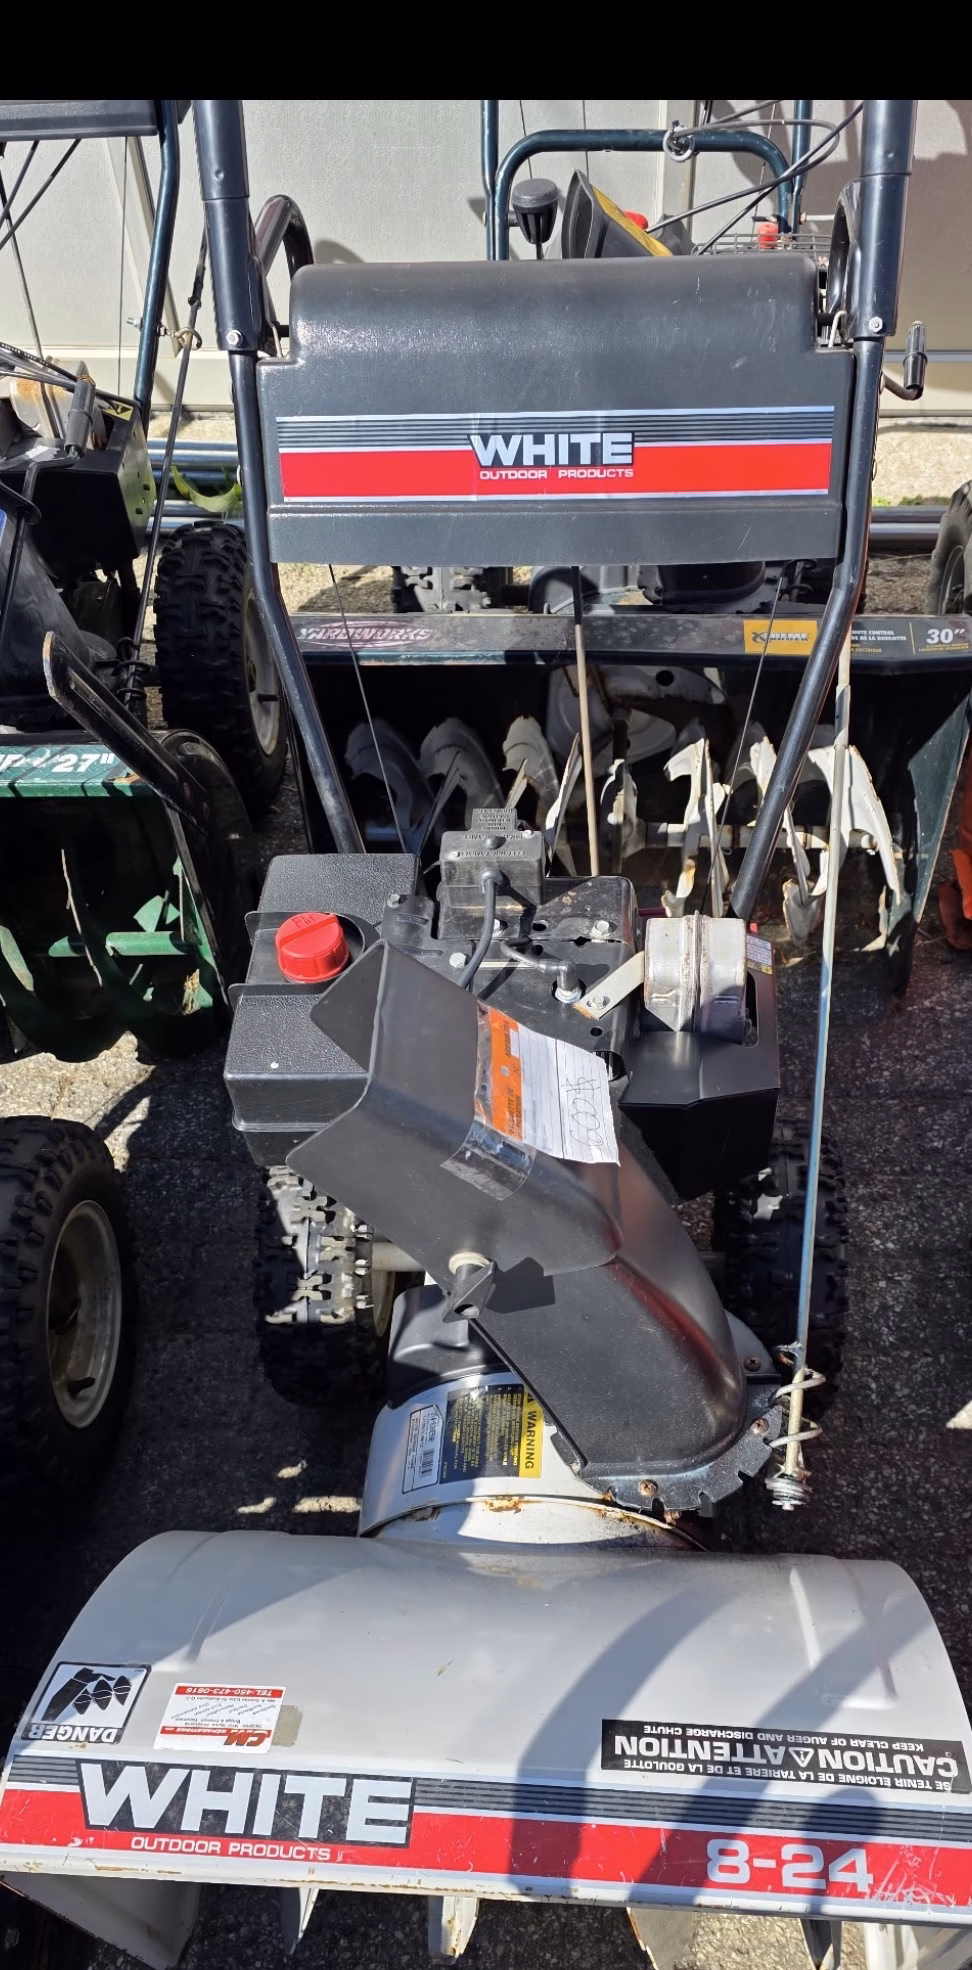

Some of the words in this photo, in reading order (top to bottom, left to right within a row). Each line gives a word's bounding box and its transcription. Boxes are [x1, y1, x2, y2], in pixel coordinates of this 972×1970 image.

[470, 434, 632, 465] WHITE
[479, 470, 547, 480] OUTDOOR
[558, 468, 634, 478] PRODUCTS
[297, 628, 431, 639] YARDWORKS
[926, 629, 965, 644] 30"
[51, 753, 115, 772] 27"
[525, 1410, 537, 1469] WARNING
[28, 1725, 118, 1743] DANGER
[643, 1725, 682, 1736] CHUTE
[686, 1727, 753, 1740] DISCHARGE
[223, 1730, 268, 1747] CM
[757, 1732, 783, 1742] AND
[786, 1734, 827, 1745] AUGER
[831, 1737, 847, 1747] OF
[850, 1738, 888, 1749] CLEAR
[891, 1741, 924, 1752] KEEP
[615, 1735, 785, 1765] ATTENTION
[623, 1759, 685, 1772] GOULOTTE
[688, 1763, 703, 1773] LA
[817, 1749, 959, 1777] CAUTION
[707, 1764, 723, 1775] DE
[726, 1766, 741, 1776] ET
[745, 1767, 795, 1779] TARIERE
[798, 1771, 814, 1781] LA
[817, 1772, 834, 1782] DE
[894, 1777, 932, 1789] TENIR
[935, 1780, 952, 1791] SE
[80, 1763, 411, 1844] WHITE
[131, 1836, 221, 1854] OUTDOOR
[229, 1841, 331, 1860] PRODUCTS
[706, 1838, 873, 1892] 8-24
